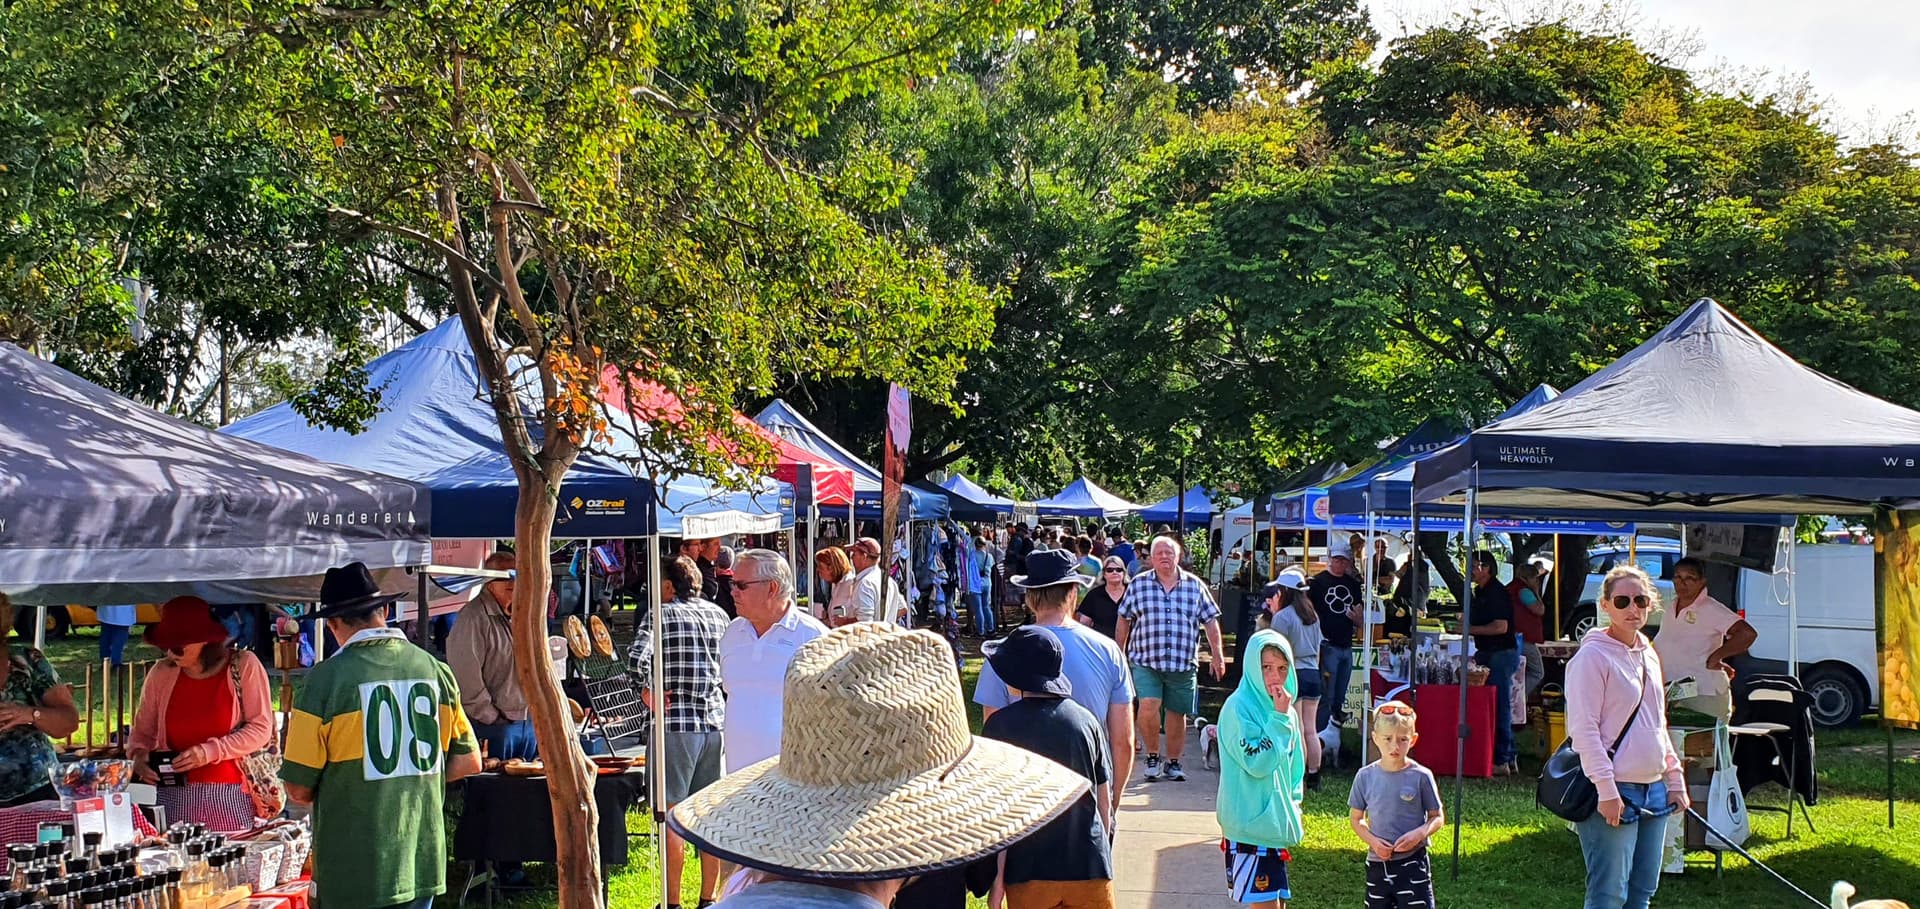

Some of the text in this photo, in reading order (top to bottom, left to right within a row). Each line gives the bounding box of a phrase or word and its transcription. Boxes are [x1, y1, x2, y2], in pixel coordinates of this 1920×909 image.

[1499, 446, 1547, 455] ULTIMATE
[1500, 455, 1554, 464] HEAVYDUTY
[306, 511, 401, 526] Wanderer
[366, 682, 440, 775] 08
